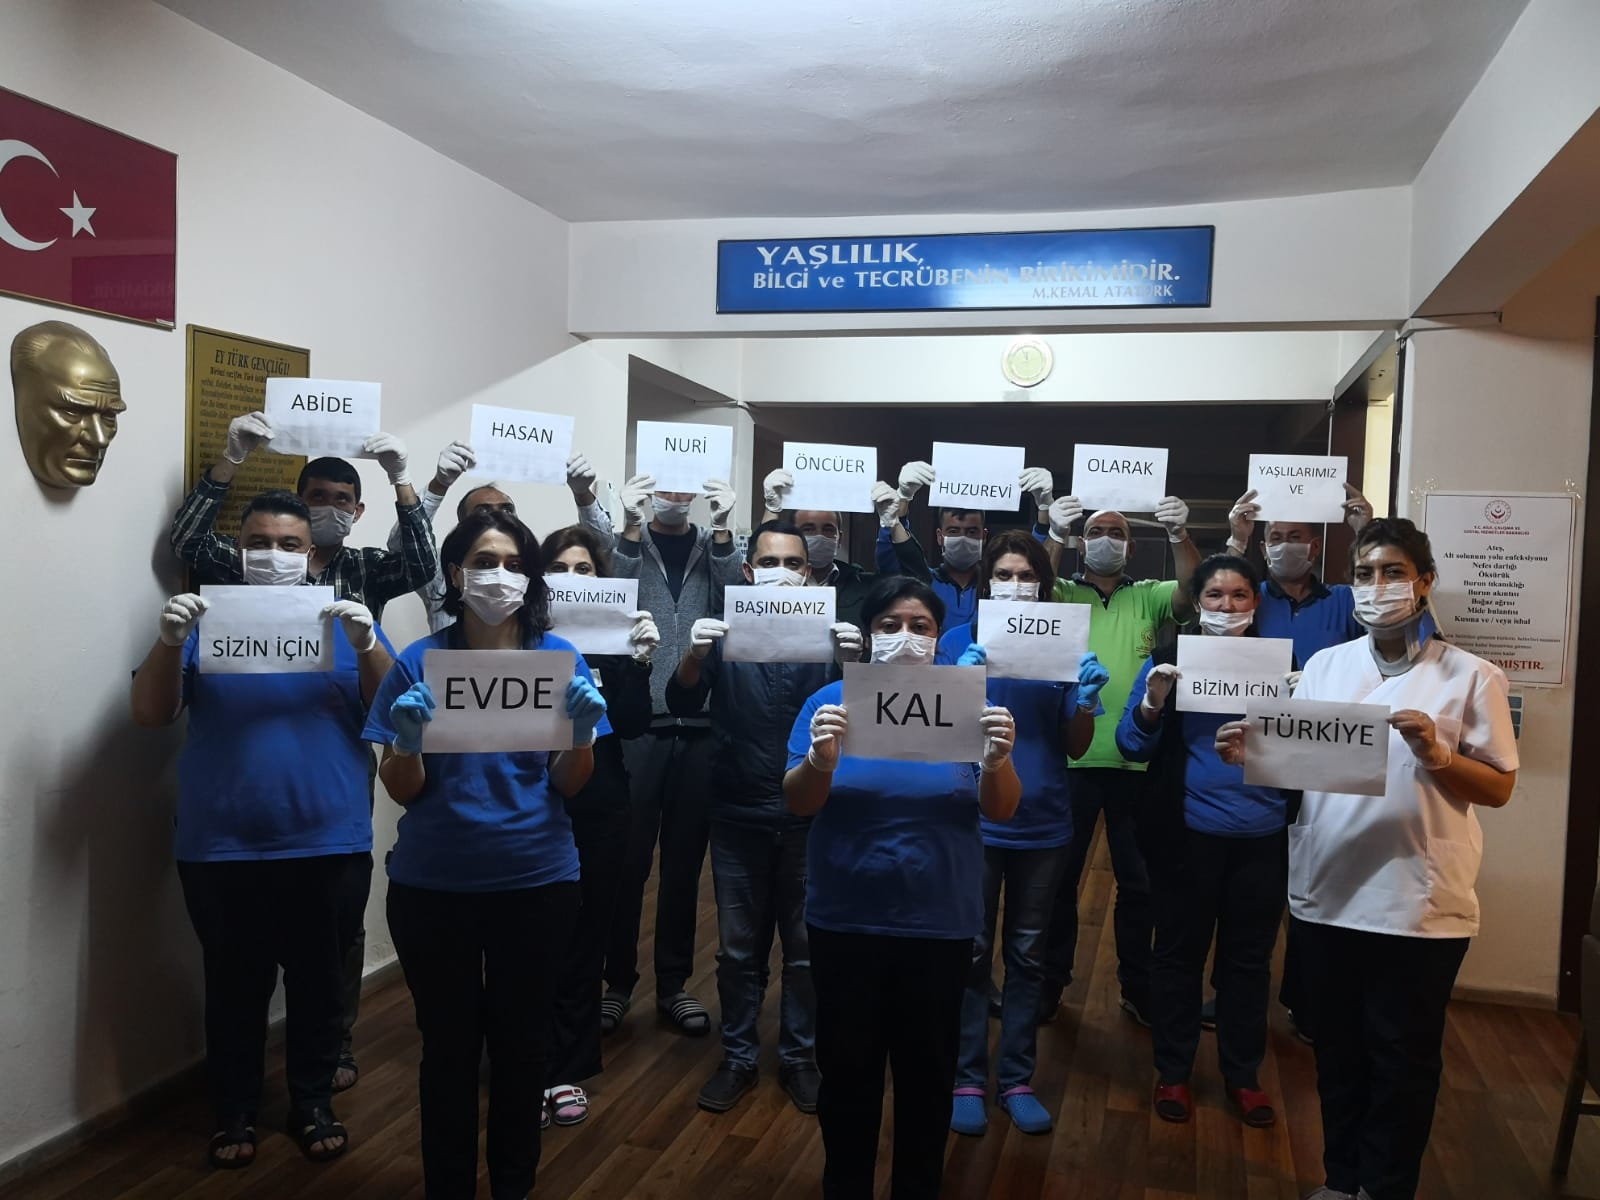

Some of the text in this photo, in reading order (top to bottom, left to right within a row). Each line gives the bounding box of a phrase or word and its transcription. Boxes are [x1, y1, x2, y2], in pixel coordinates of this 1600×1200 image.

[756, 243, 924, 269] YAŞLILIK,
[754, 259, 1180, 288] BİLGİ ve TECRÜBENİN BİRİKİMİDİR.
[1032, 286, 1099, 299] M.KEMAL
[215, 350, 225, 364] EY
[228, 348, 249, 368] TÜRK
[291, 392, 353, 414] ABİDE
[491, 421, 553, 444] HASAN
[665, 436, 707, 454] NURİ
[795, 453, 865, 474] ÖNCÜER
[1087, 458, 1154, 476] OLARAK
[1259, 466, 1337, 479] YAŞLILARIMIZ
[939, 481, 1013, 499] HUZUREVİ
[1289, 484, 1304, 495] VE
[1505, 554, 1548, 562] enfeksiyonu
[1478, 570, 1510, 579] Öksürük
[548, 588, 626, 604] ÖREVİMİZİN
[735, 600, 826, 617] BAŞINDAYIZ
[1006, 614, 1062, 636] SİZDE
[212, 636, 320, 661] SİZİN İÇİN
[1490, 660, 1544, 672] NMIŞTIR.
[445, 677, 554, 710] EVDE
[1192, 678, 1239, 697] BİZİM
[876, 691, 954, 728] KAL
[1258, 713, 1375, 746] TÜRKİYE
